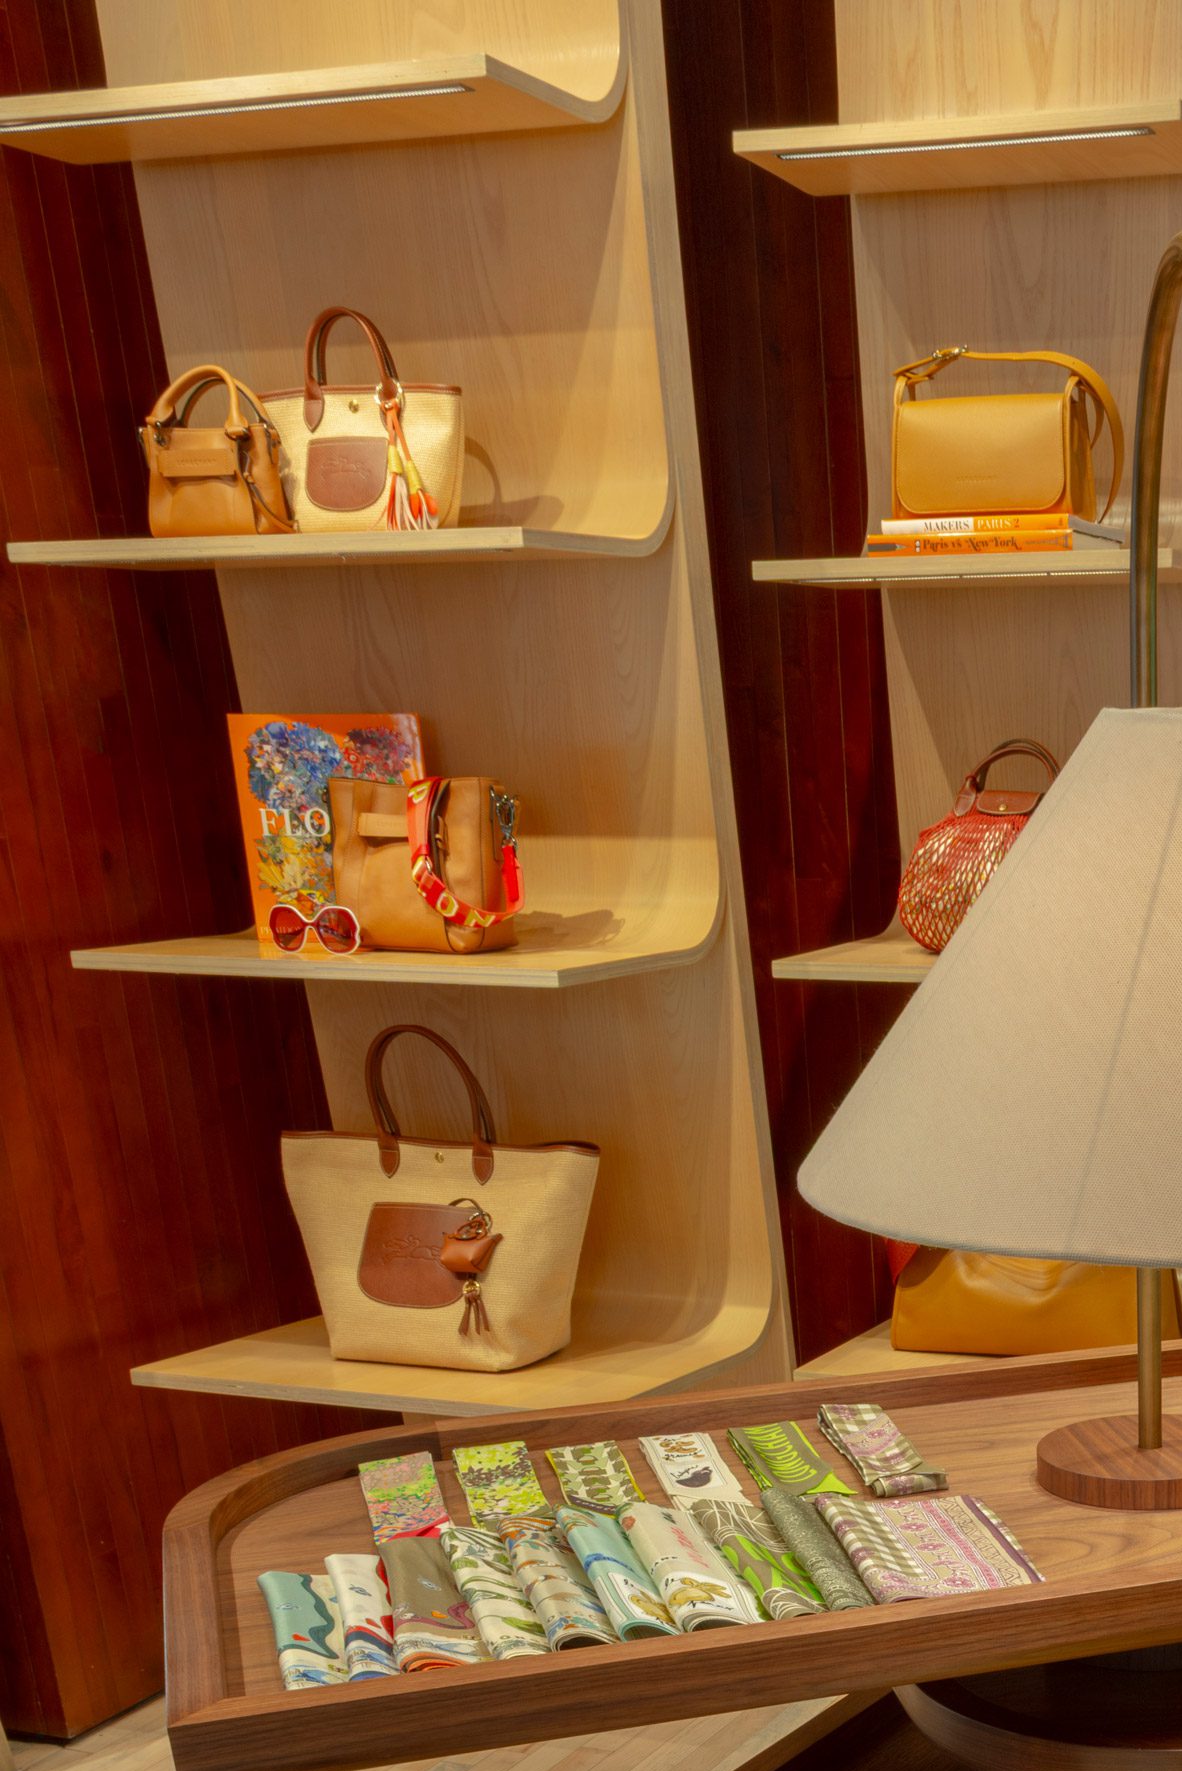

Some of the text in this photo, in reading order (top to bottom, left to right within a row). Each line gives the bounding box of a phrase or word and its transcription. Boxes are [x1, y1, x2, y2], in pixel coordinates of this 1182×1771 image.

[923, 521, 970, 532] MAKERS
[977, 519, 1012, 530] PARIS
[922, 539, 949, 552] Paris
[964, 537, 989, 552] New
[989, 536, 1022, 551] York
